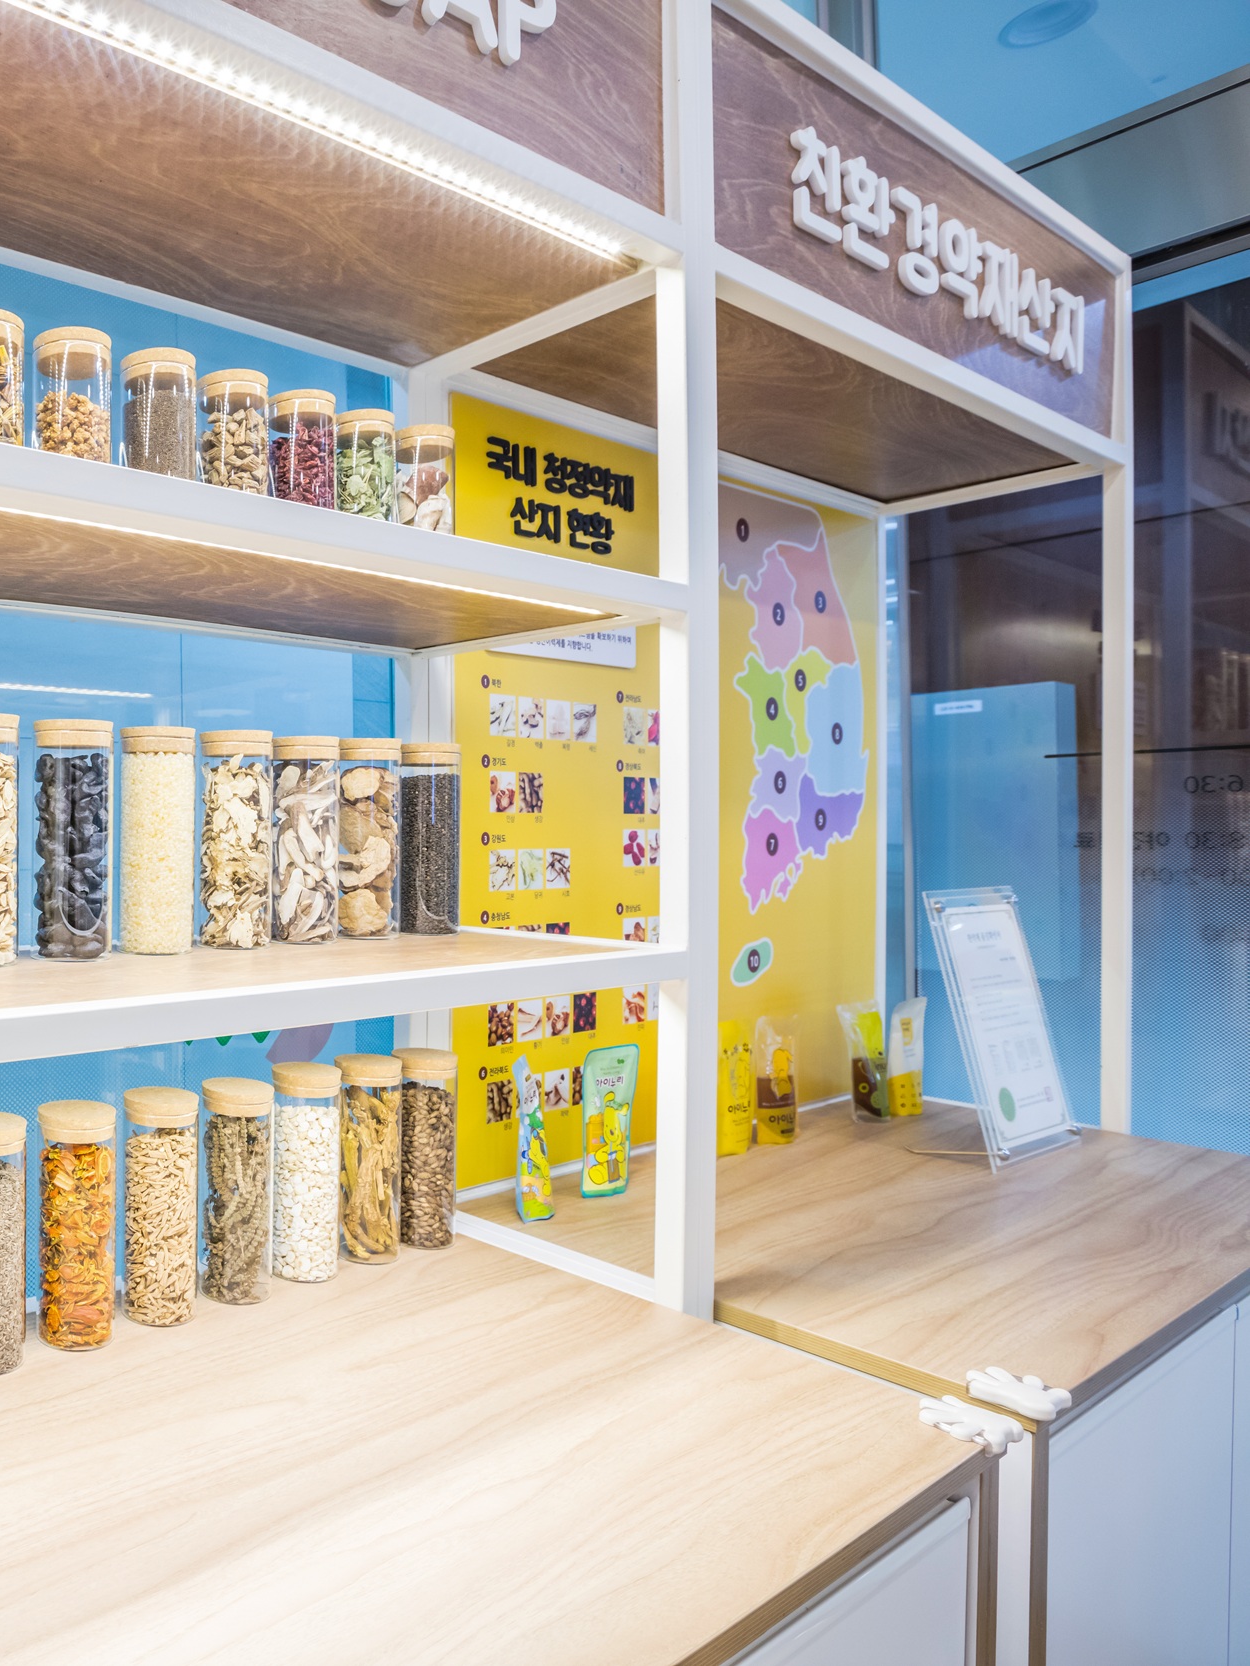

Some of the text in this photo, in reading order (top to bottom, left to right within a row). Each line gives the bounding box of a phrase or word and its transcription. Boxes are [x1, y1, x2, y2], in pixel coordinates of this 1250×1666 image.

[790, 126, 1084, 374] 친환경약재산지
[486, 436, 634, 512] 국내 청정약재
[510, 497, 615, 555] 산지 현황
[492, 757, 506, 766] 경기도
[492, 834, 506, 844] 강원도
[491, 912, 510, 922] 충청남도
